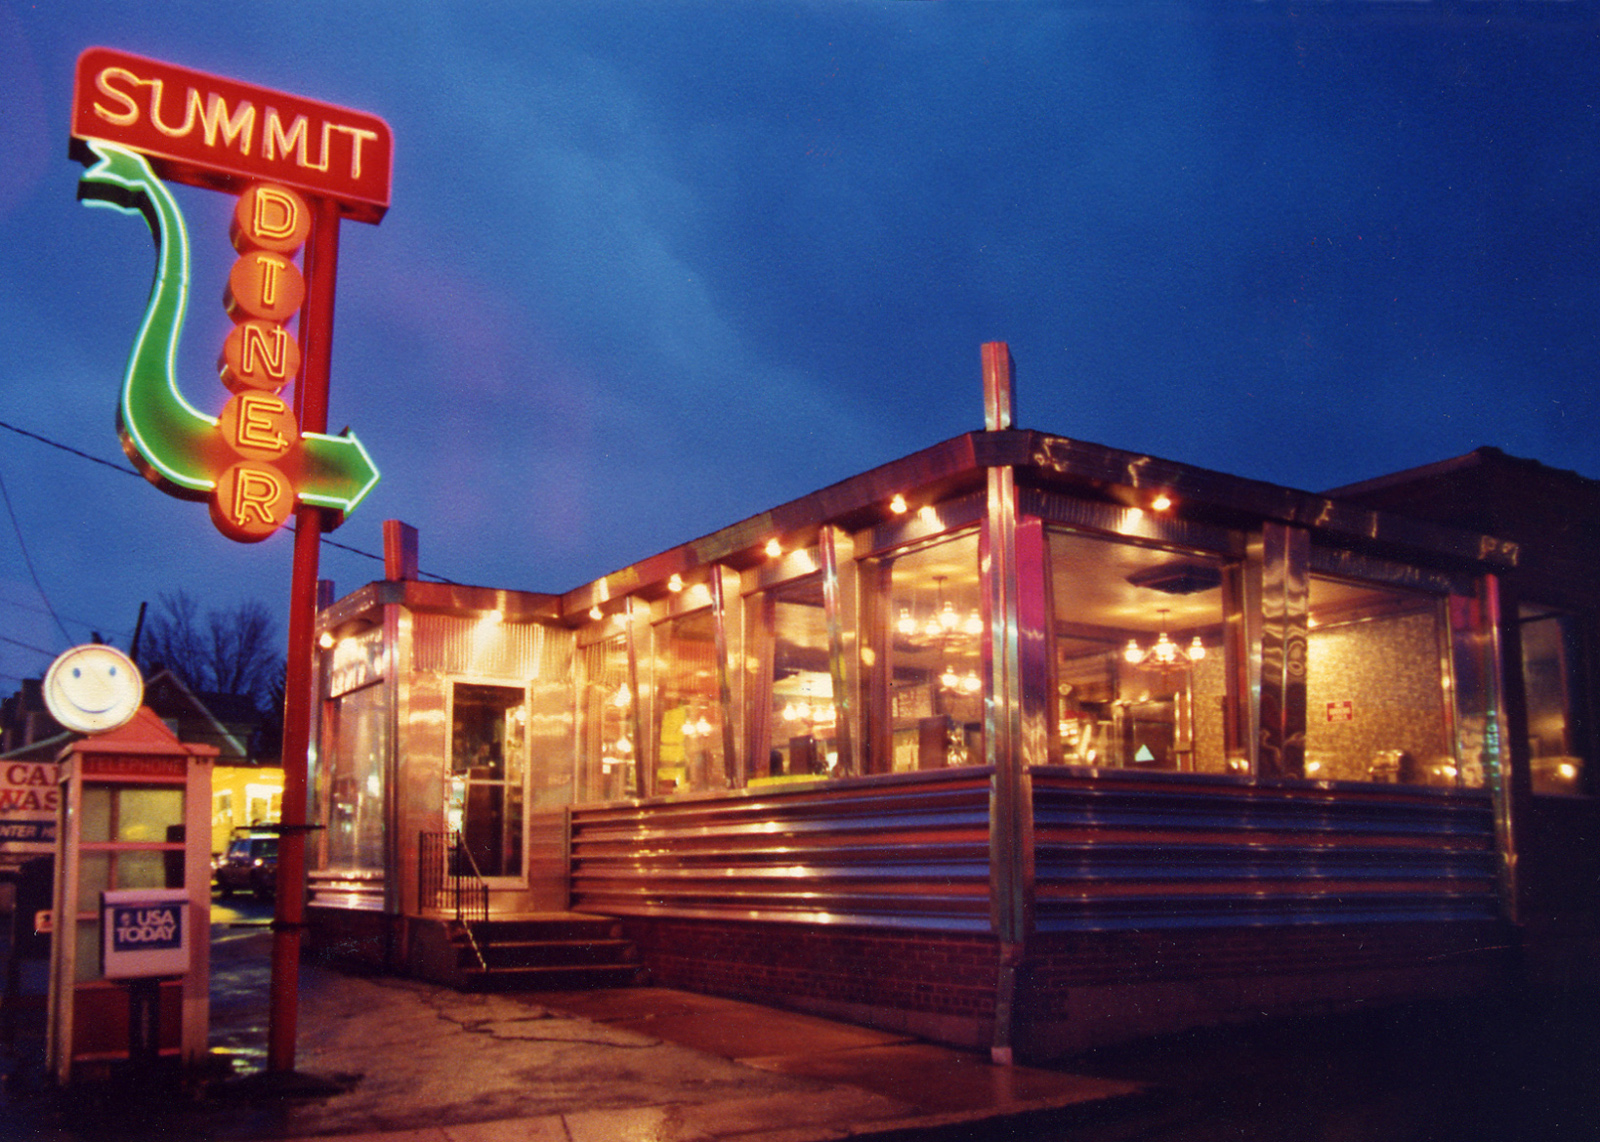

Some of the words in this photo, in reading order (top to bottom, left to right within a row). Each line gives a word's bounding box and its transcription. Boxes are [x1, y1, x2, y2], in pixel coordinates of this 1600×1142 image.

[93, 67, 378, 179] SUMMIT
[233, 187, 298, 526] DINER
[117, 926, 176, 942] TODAY
[137, 909, 174, 926] USA
